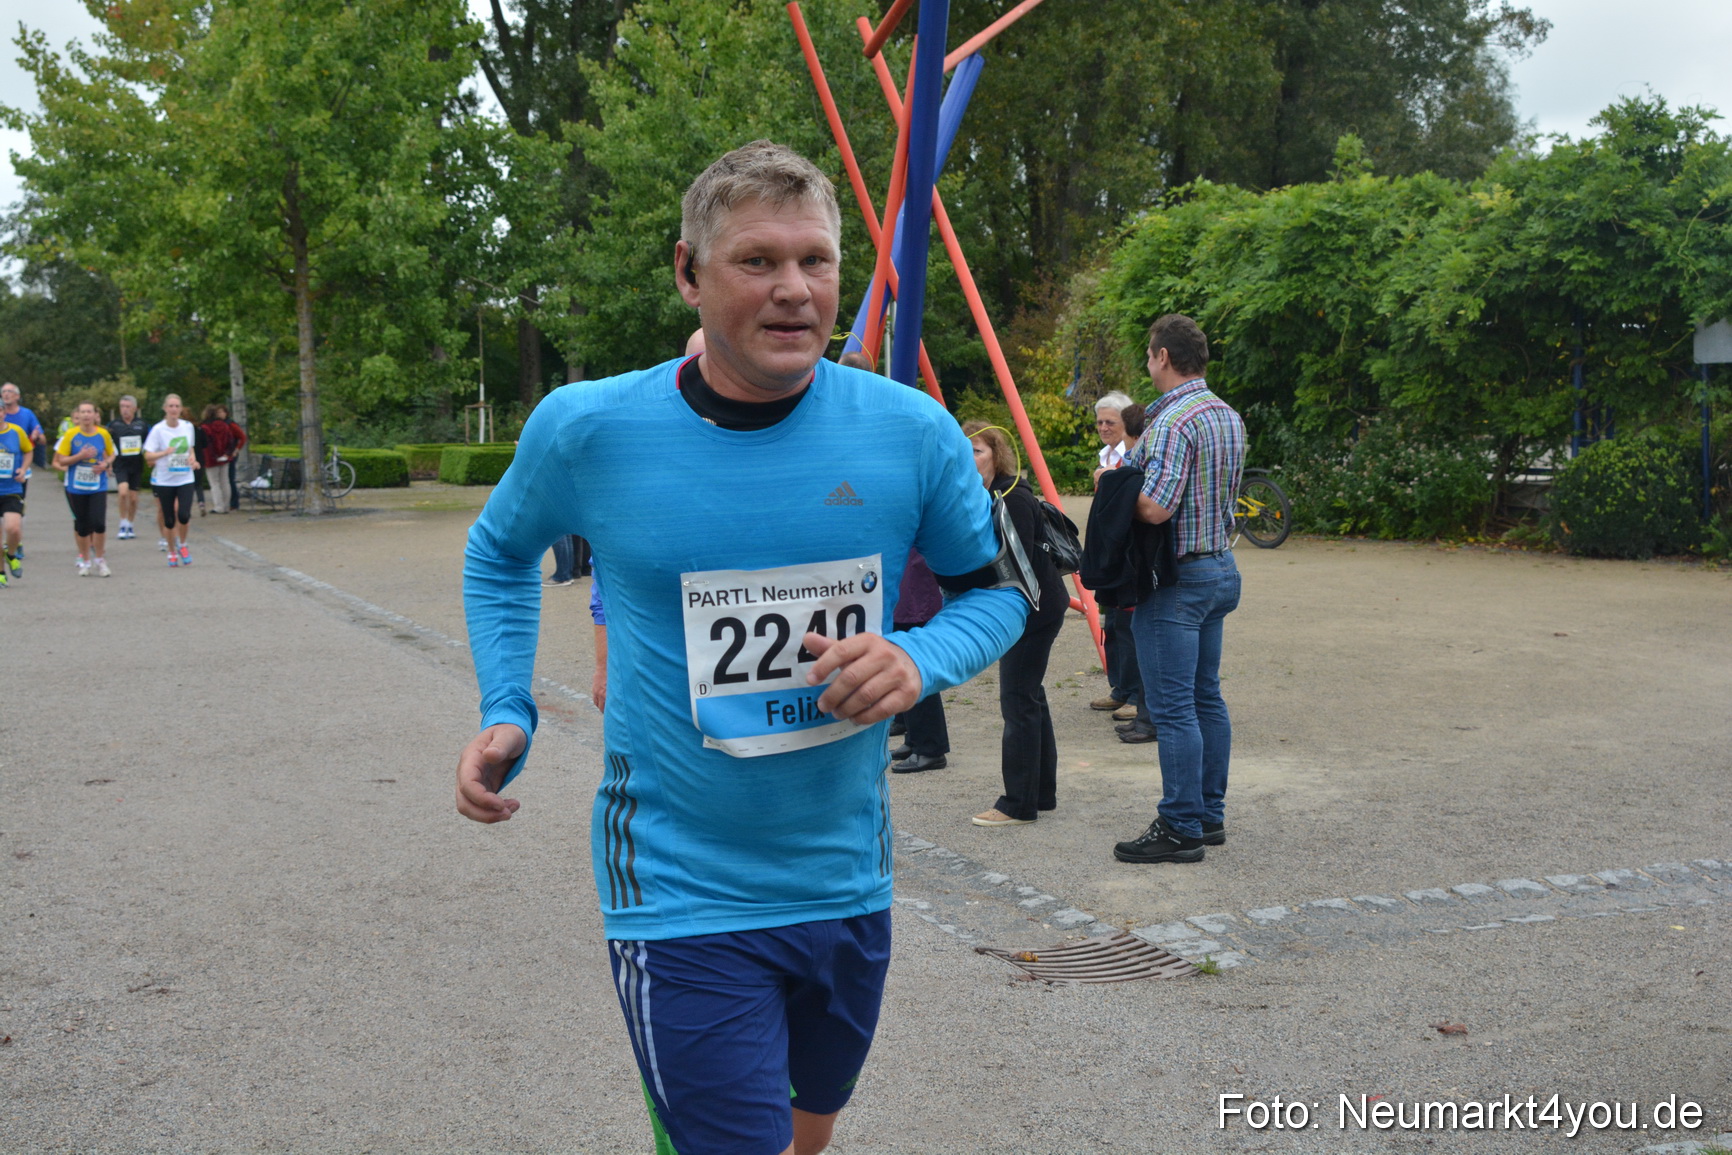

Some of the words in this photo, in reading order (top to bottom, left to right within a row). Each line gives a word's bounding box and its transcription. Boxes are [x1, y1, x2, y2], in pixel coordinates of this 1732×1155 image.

[824, 497, 864, 506] adidas
[689, 588, 757, 608] PARTL
[762, 580, 854, 602] Neumarkt
[699, 683, 707, 695] D
